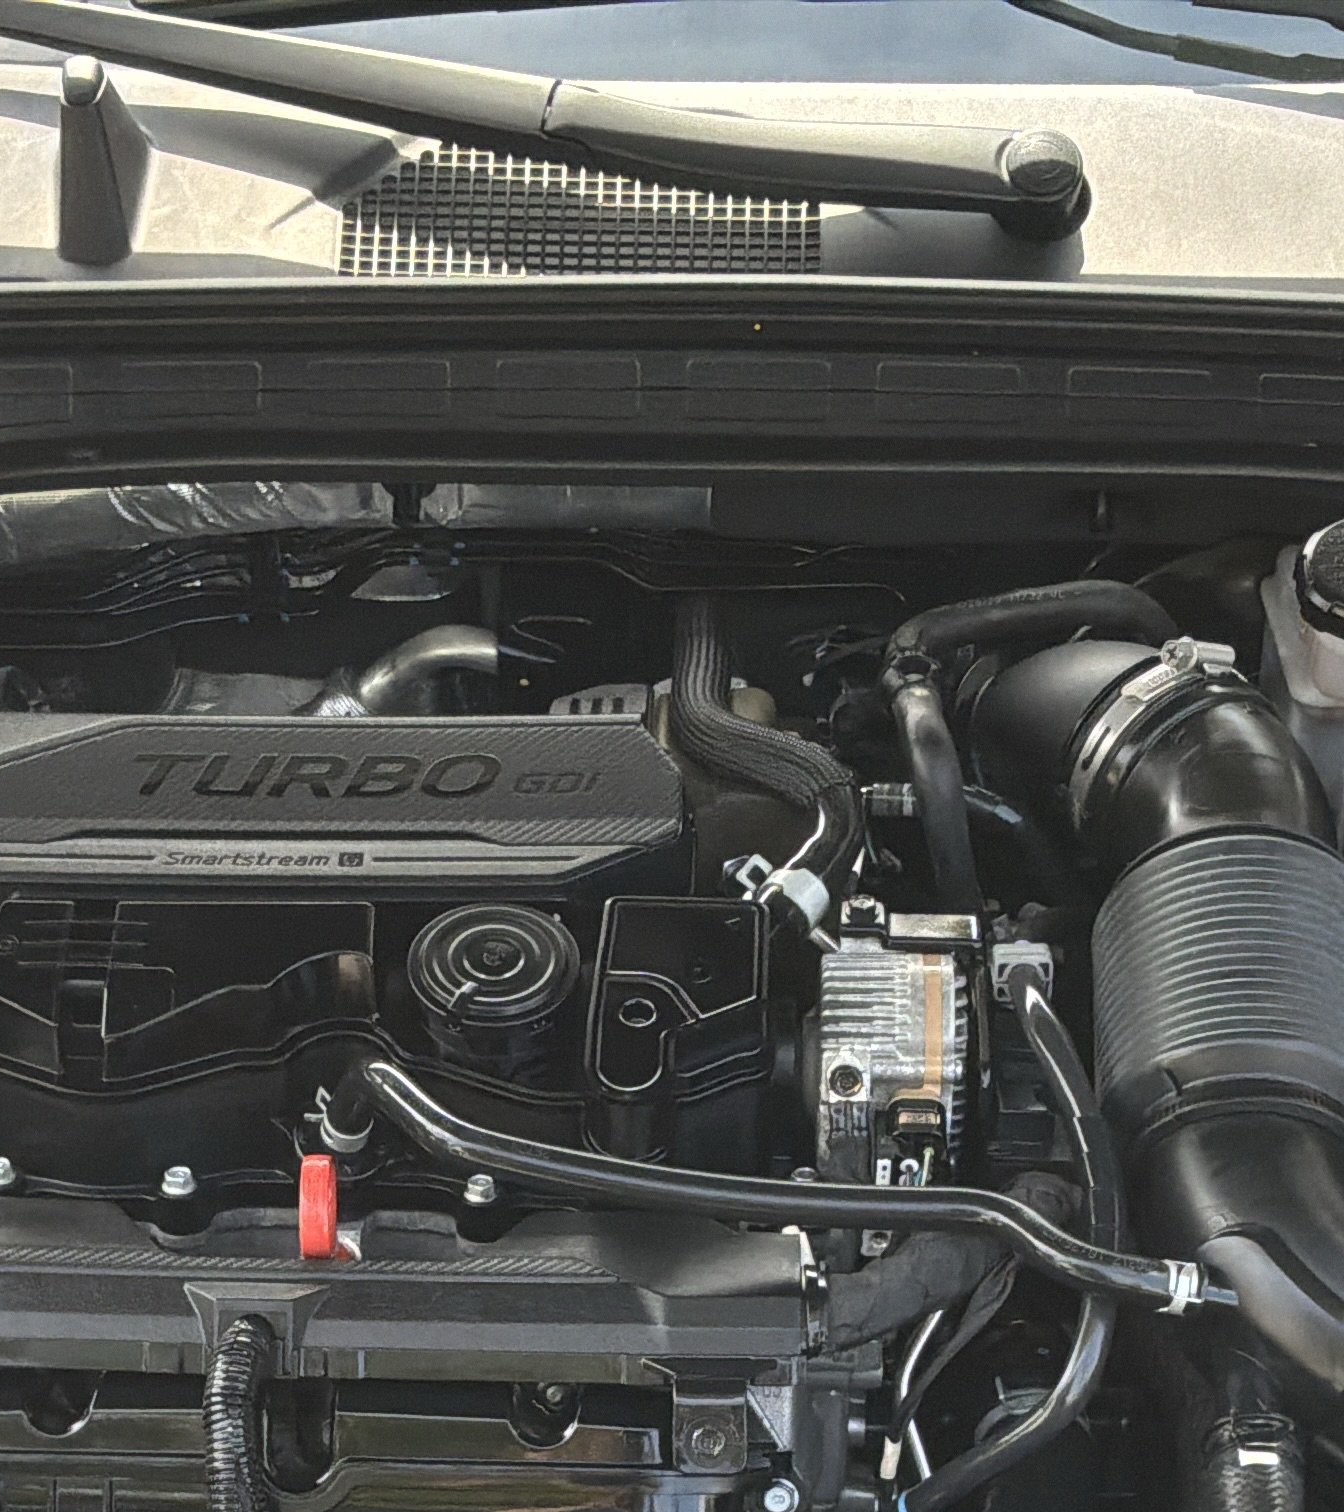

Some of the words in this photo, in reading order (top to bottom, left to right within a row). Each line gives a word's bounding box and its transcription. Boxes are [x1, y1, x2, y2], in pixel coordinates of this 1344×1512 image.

[135, 753, 502, 799] TURBO
[513, 772, 600, 795] GDI
[162, 851, 330, 867] Smartstream
